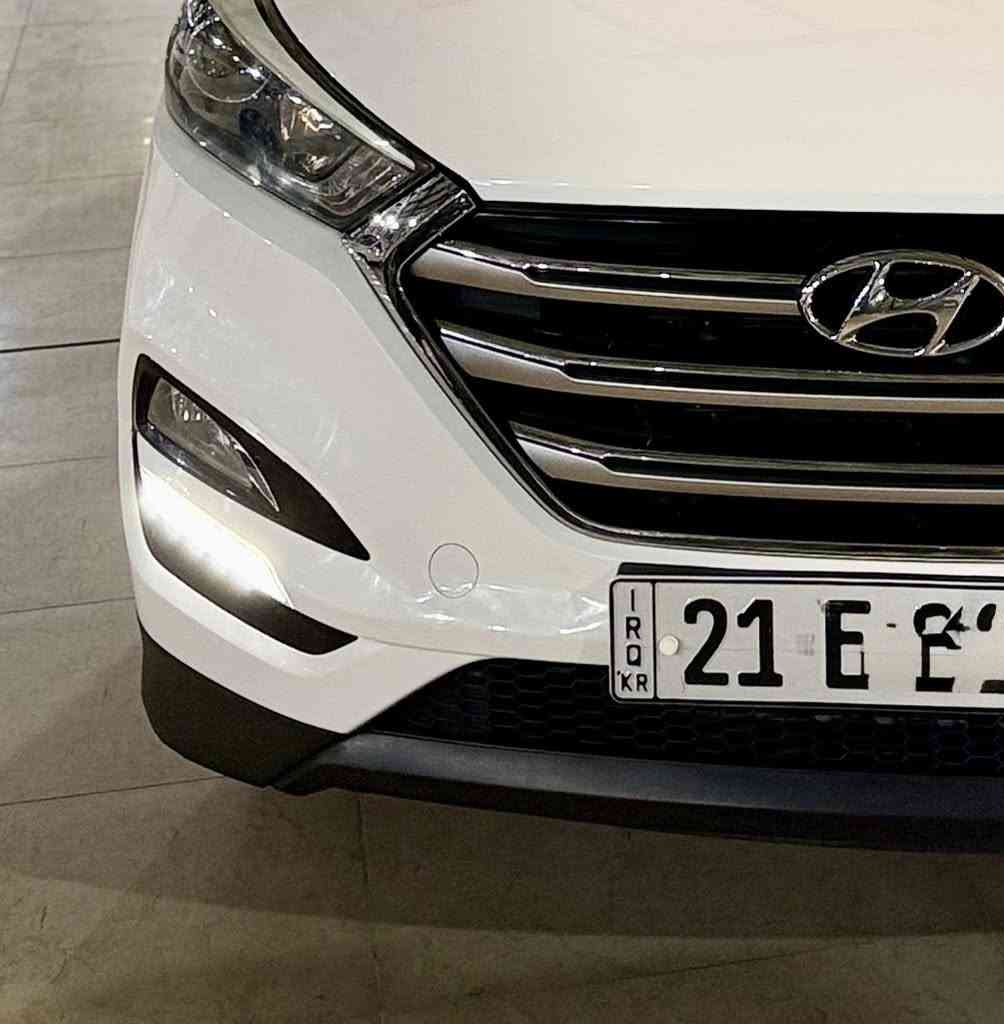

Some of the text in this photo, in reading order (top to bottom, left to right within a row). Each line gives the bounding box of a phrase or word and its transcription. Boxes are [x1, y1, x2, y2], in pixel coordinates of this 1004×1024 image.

[684, 598, 783, 687] 21
[825, 600, 871, 689] E
[621, 673, 648, 692] KR
